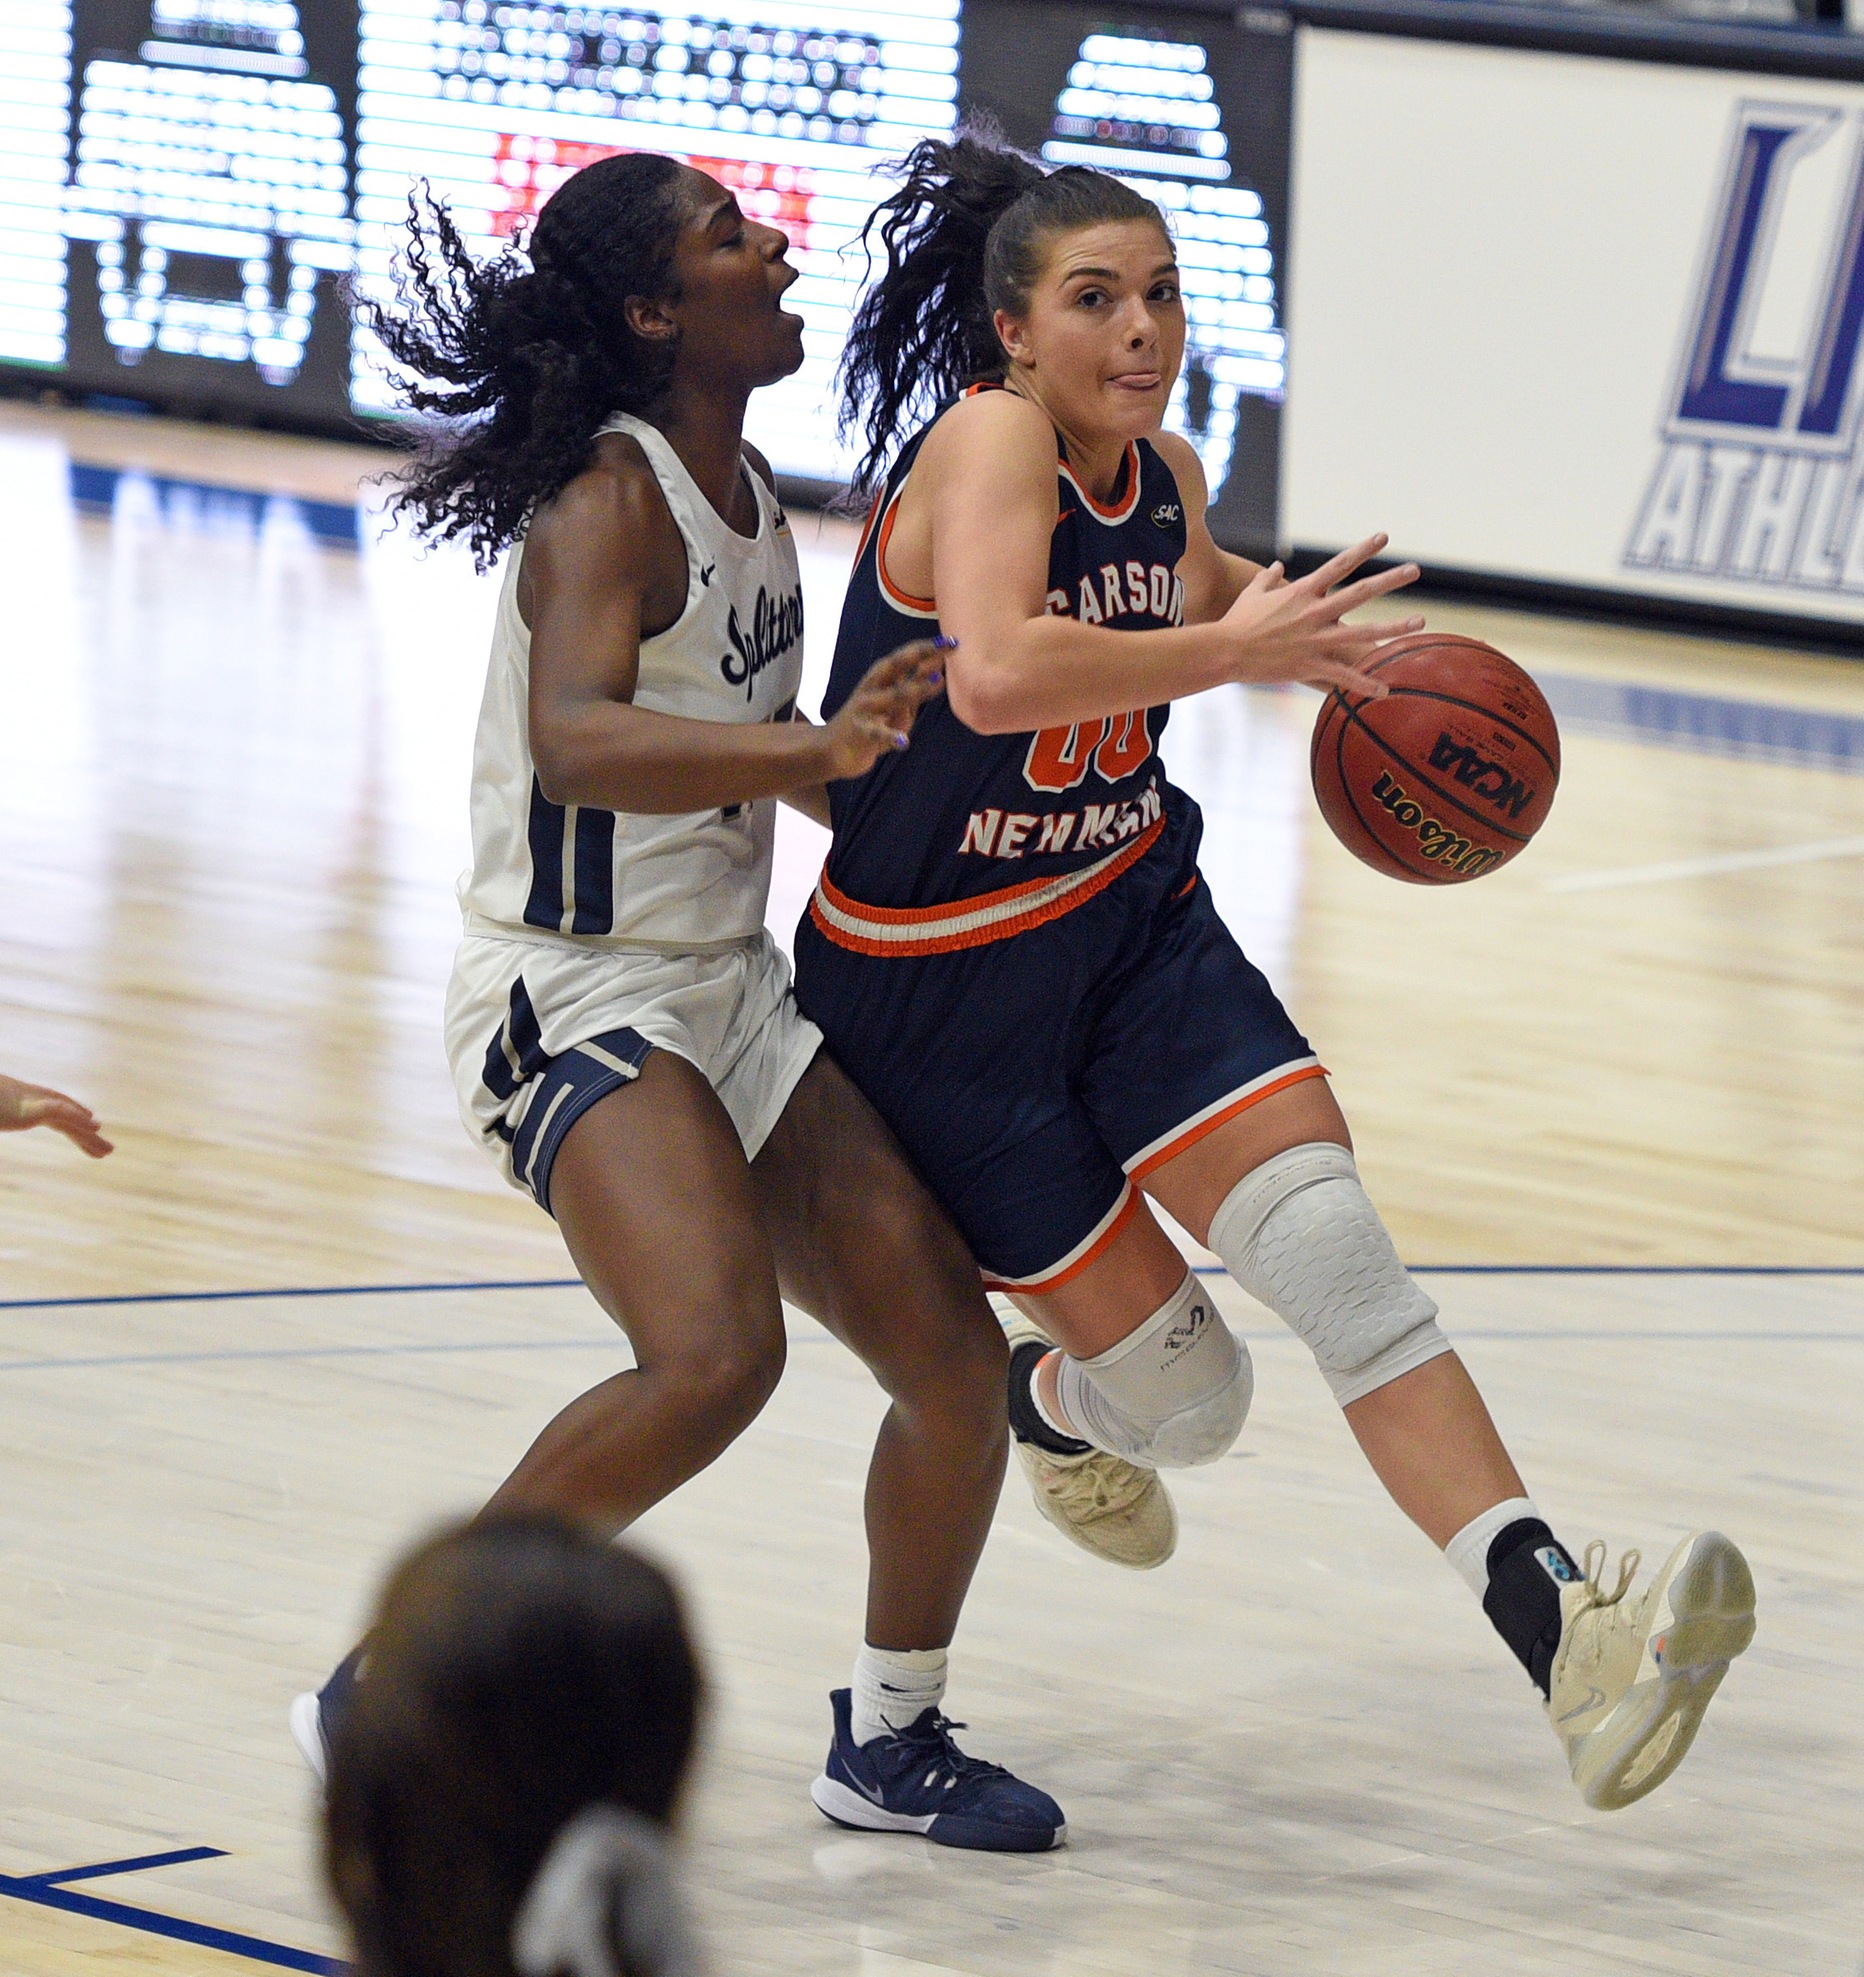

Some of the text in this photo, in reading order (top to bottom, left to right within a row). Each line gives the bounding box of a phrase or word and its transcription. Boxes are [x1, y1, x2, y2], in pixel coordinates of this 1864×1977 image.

[1153, 504, 1180, 522] SAC
[957, 773, 1161, 859] NEWMAN
[1428, 731, 1536, 820] NCAA
[1371, 769, 1506, 875] Wilson
